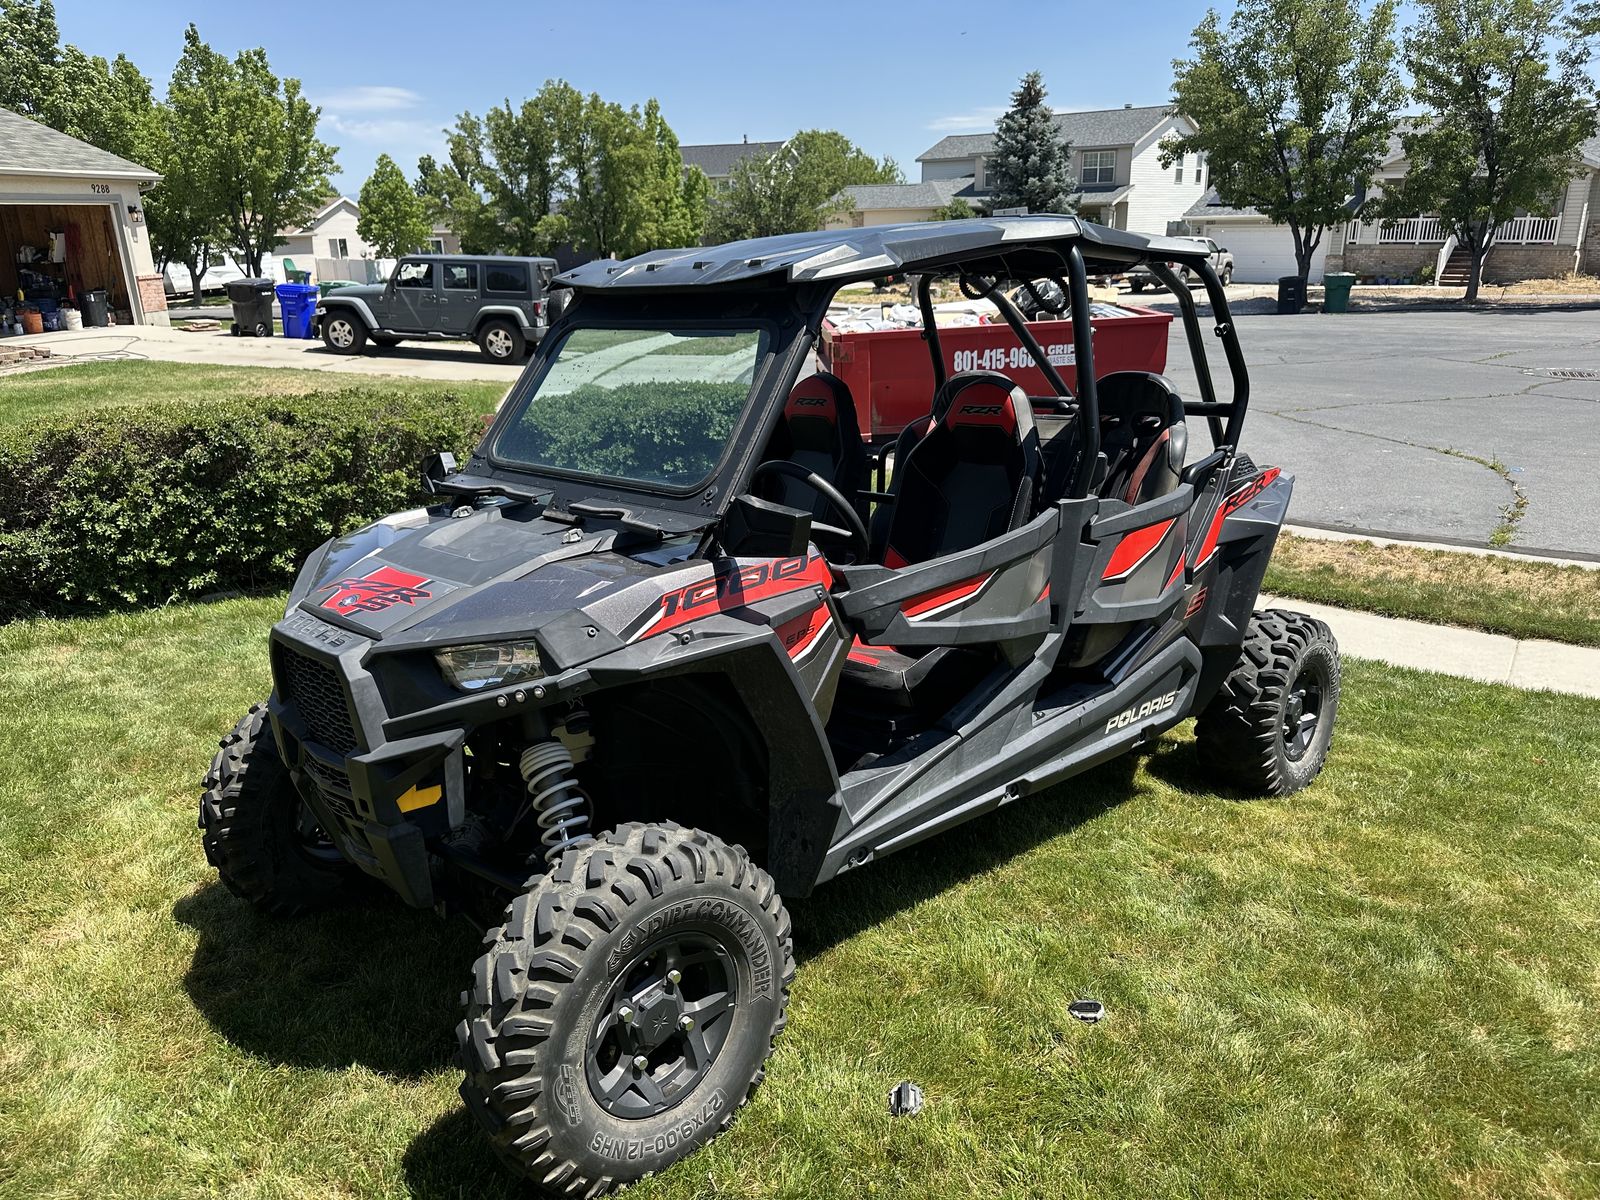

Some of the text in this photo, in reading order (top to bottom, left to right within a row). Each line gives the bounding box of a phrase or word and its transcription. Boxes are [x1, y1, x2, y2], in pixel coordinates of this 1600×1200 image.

[91, 183, 110, 194] 9288
[953, 346, 1045, 372] 801-415-968
[1047, 343, 1075, 355] GRIF
[794, 397, 828, 407] RZR
[958, 404, 1003, 416] RZR
[1221, 473, 1266, 516] RZR
[317, 578, 433, 607] RZR
[662, 552, 809, 619] 1000
[785, 623, 816, 646] EPS
[1104, 690, 1177, 734] POLARIS
[644, 900, 773, 994] DIRT COMMANDER
[590, 1131, 625, 1160] NHS
